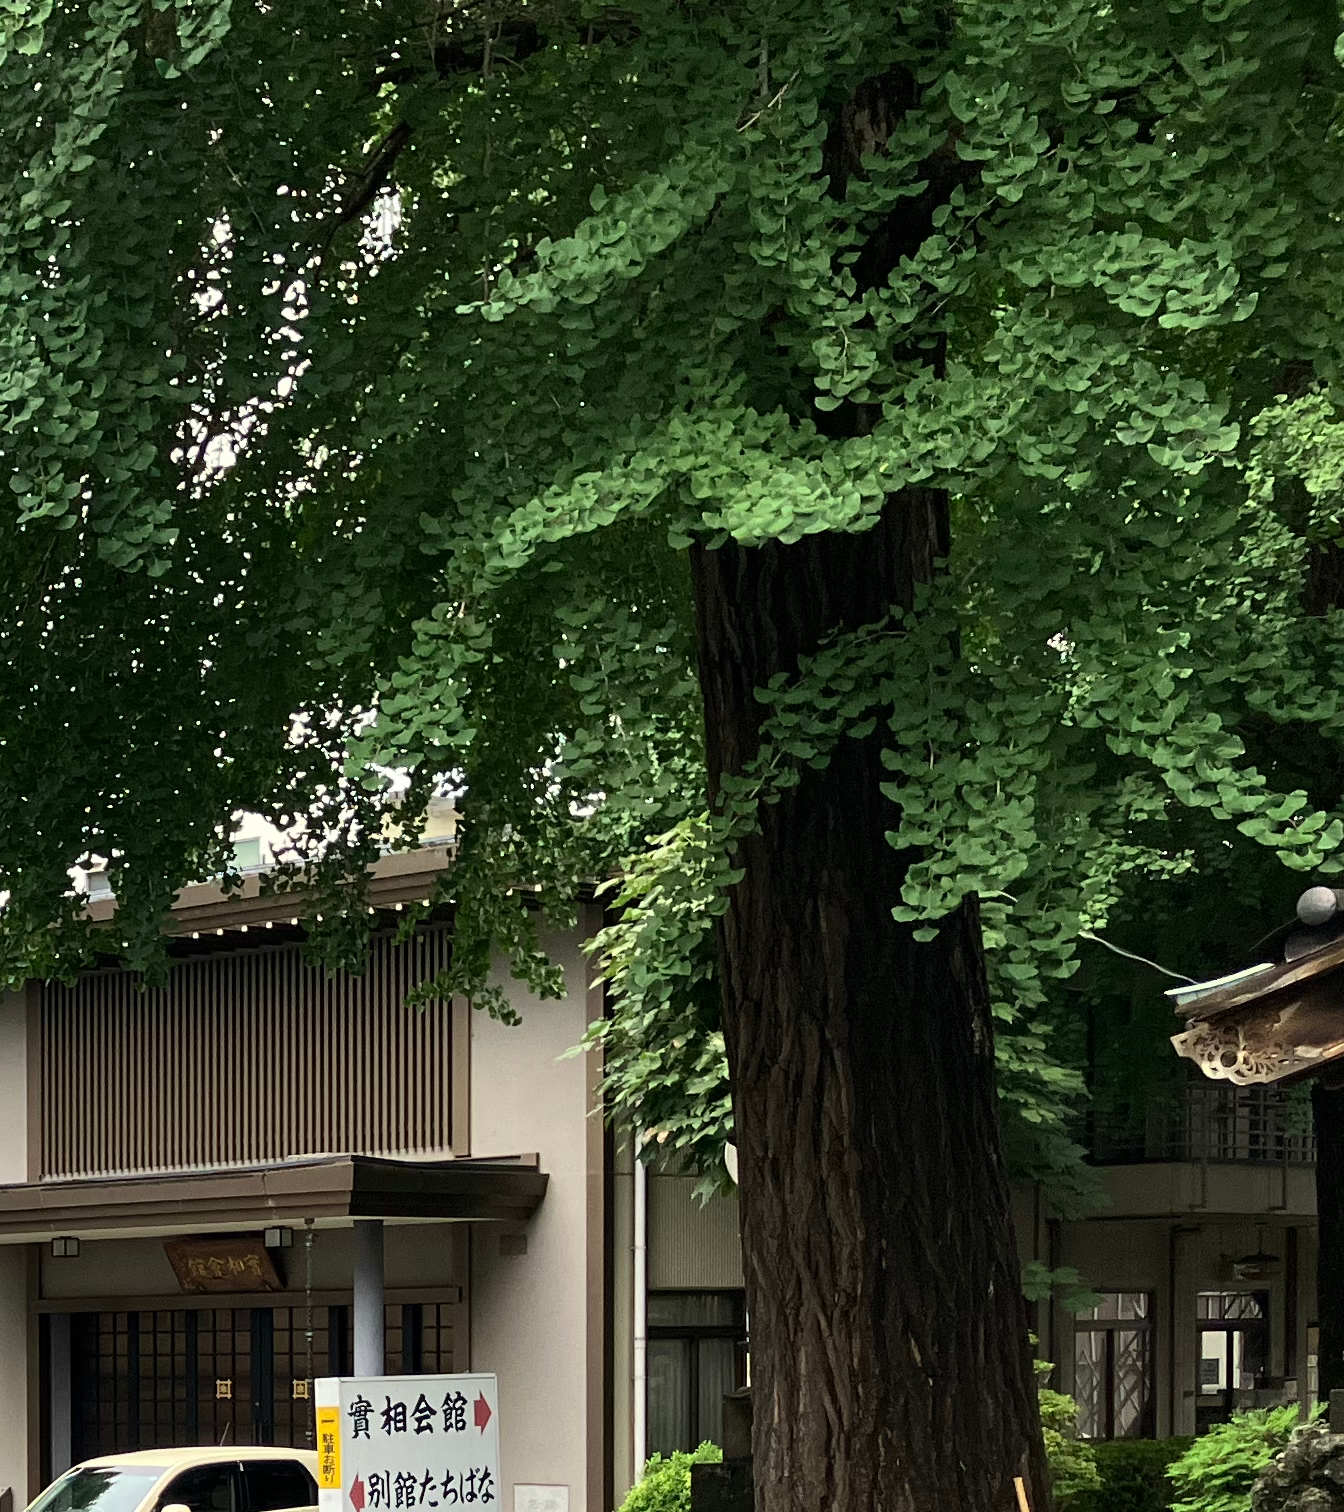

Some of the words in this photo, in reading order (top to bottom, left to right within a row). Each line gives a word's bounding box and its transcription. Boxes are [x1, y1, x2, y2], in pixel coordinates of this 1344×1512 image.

[348, 1391, 468, 1439] 實相会館
[368, 1465, 495, 1509] 別館たちばな
